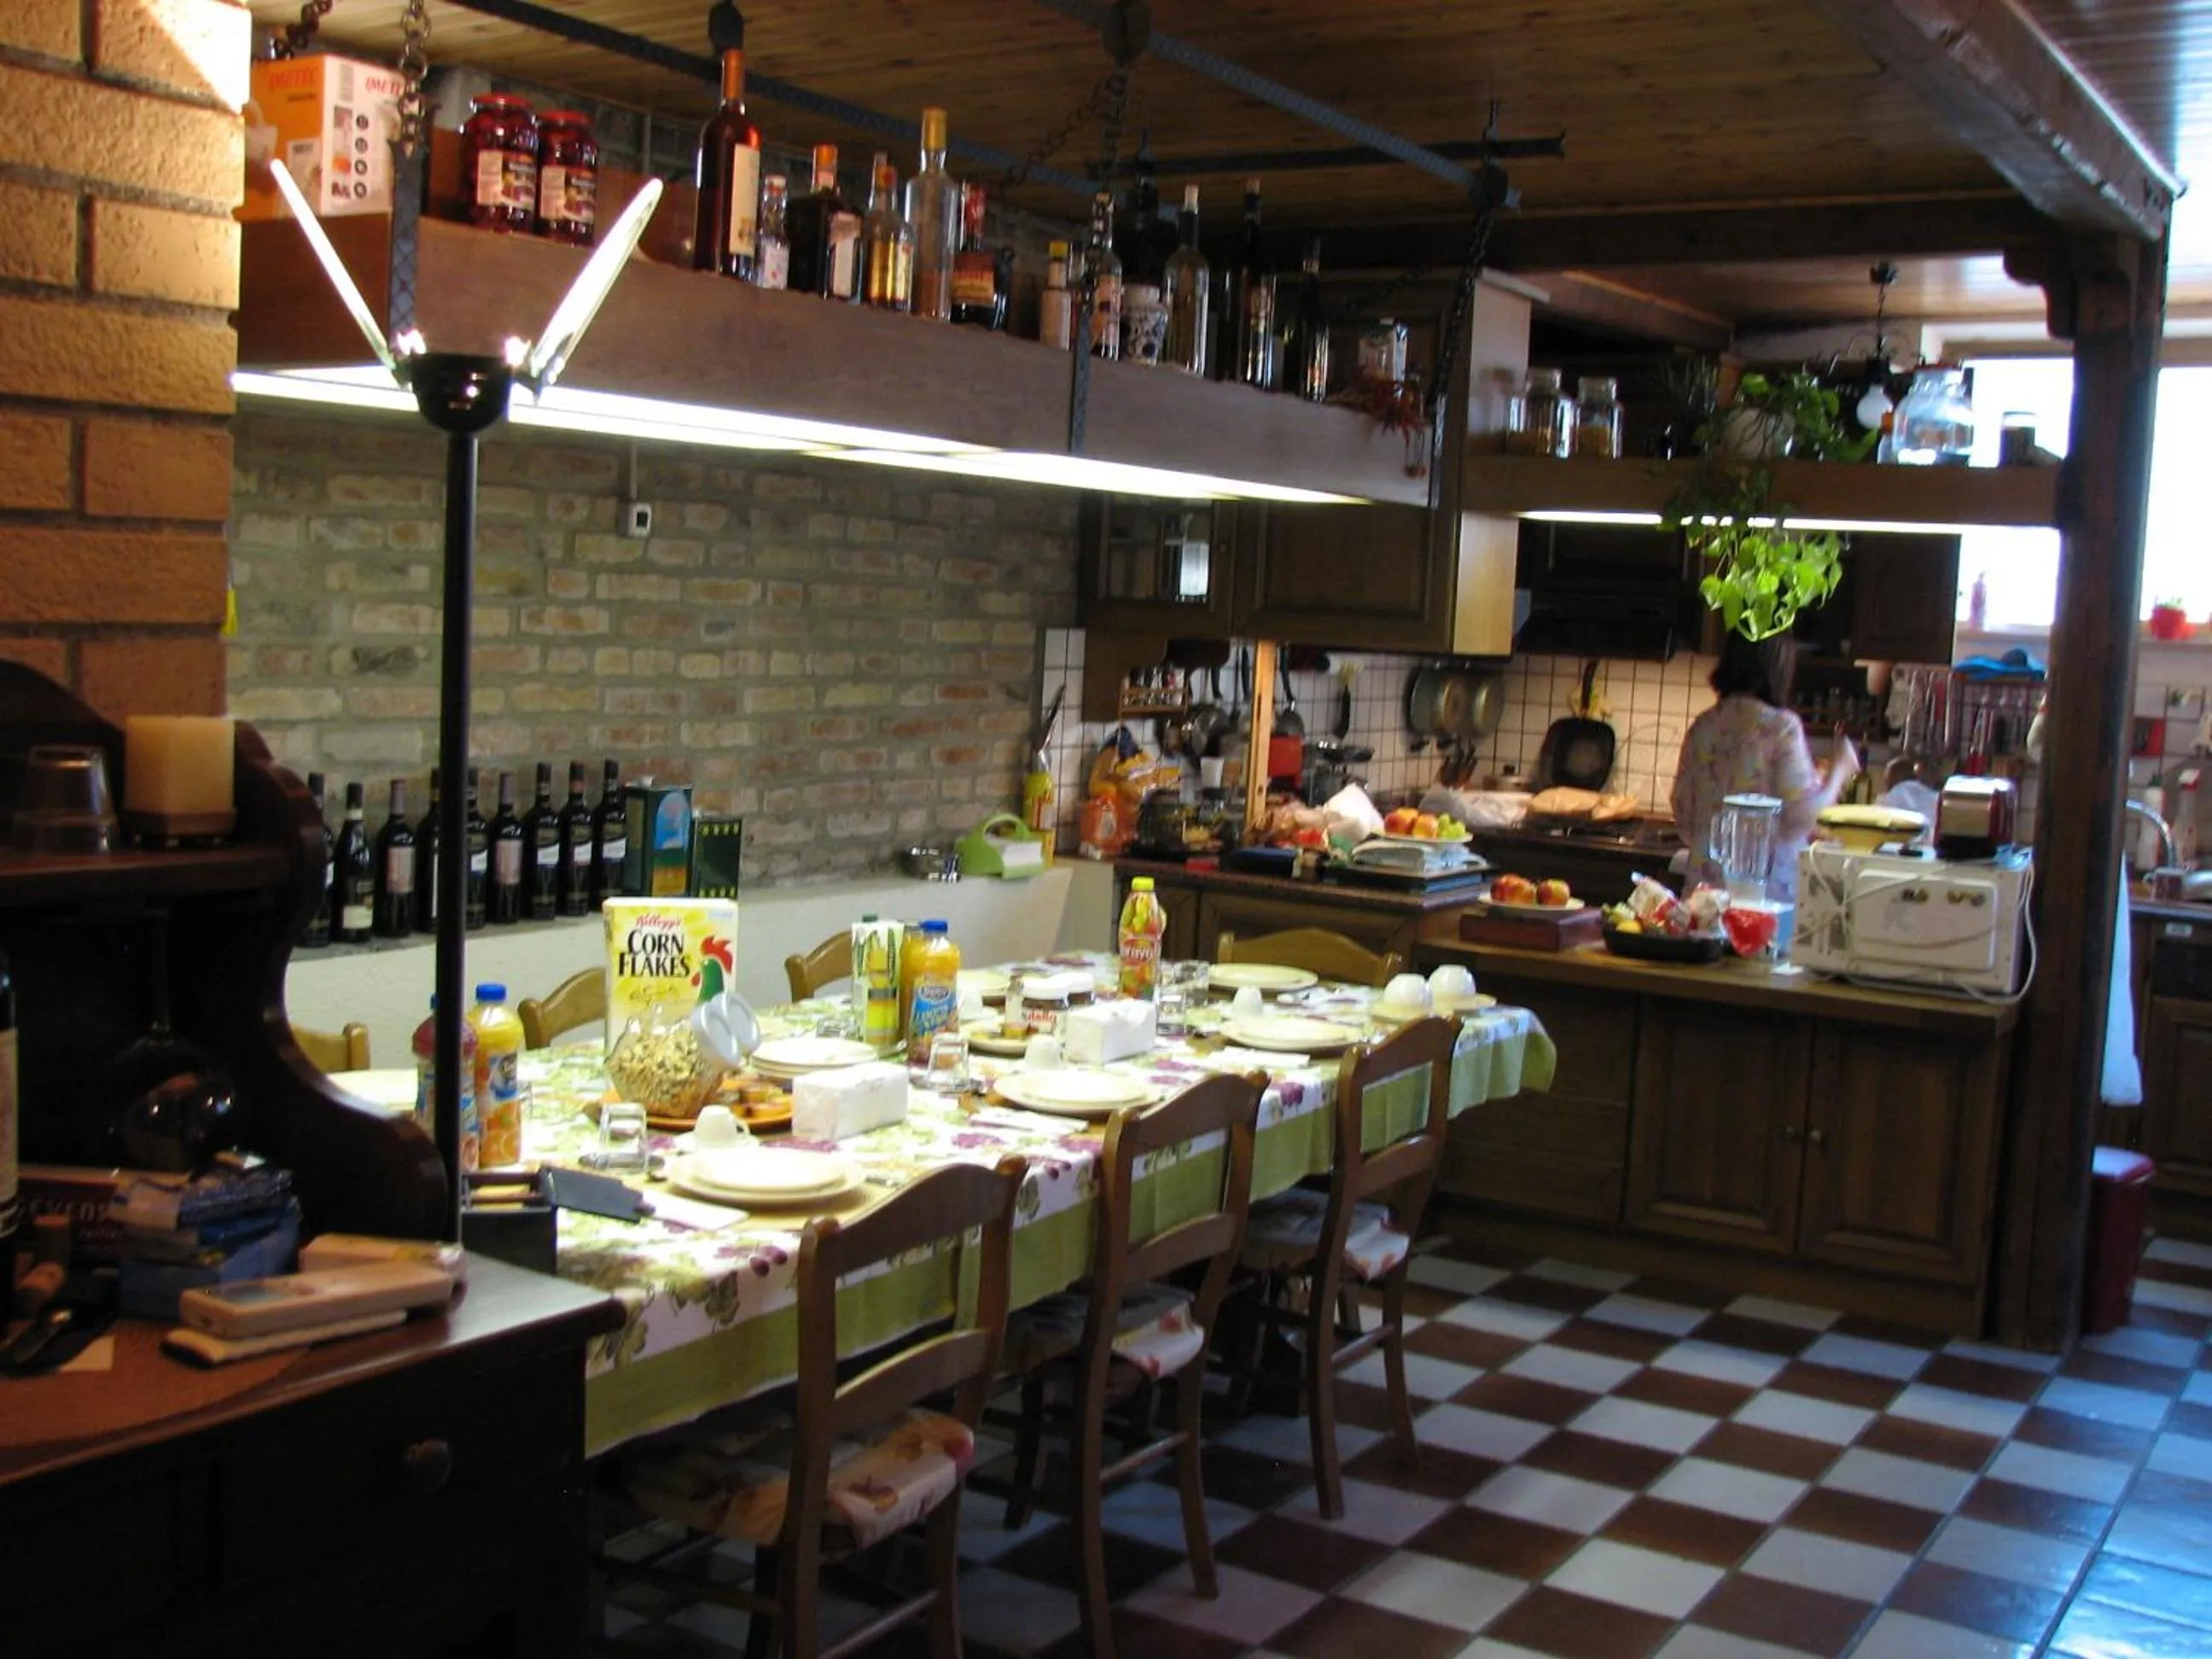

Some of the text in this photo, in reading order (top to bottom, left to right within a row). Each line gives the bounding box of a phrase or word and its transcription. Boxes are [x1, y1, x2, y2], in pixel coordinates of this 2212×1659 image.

[365, 75, 402, 97] IMETE
[636, 913, 682, 930] Kellogg's
[627, 928, 684, 956] CORN
[618, 952, 690, 978] FLAKES
